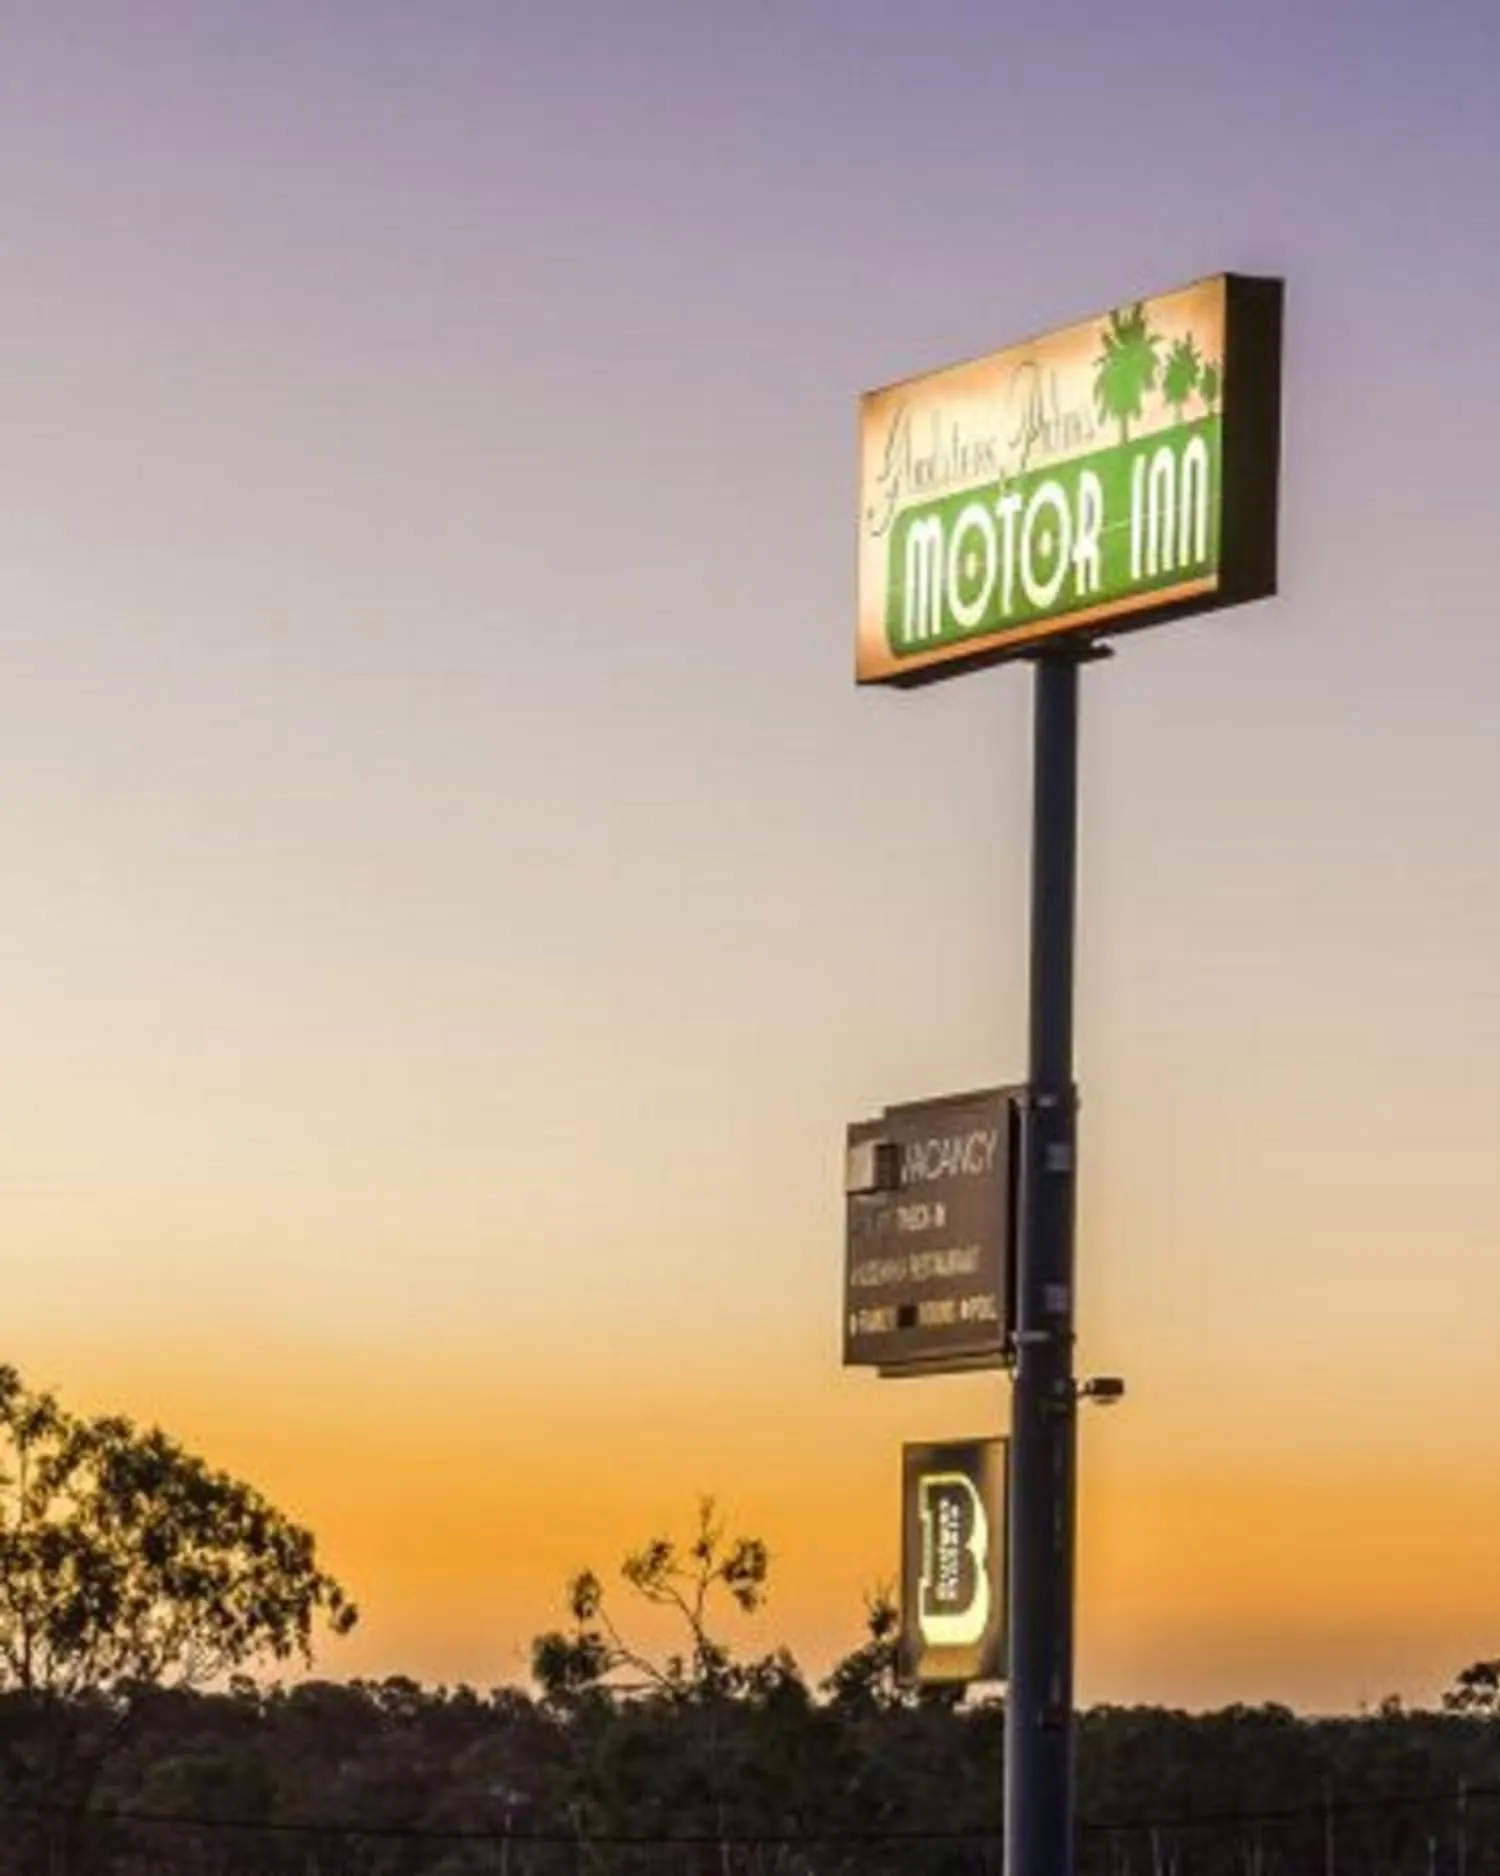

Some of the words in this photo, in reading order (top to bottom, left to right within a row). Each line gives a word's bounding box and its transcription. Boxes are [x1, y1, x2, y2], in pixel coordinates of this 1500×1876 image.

[904, 469, 1103, 643] MOTOR
[1130, 436, 1209, 581] INN
[902, 1129, 999, 1183] VACANCY
